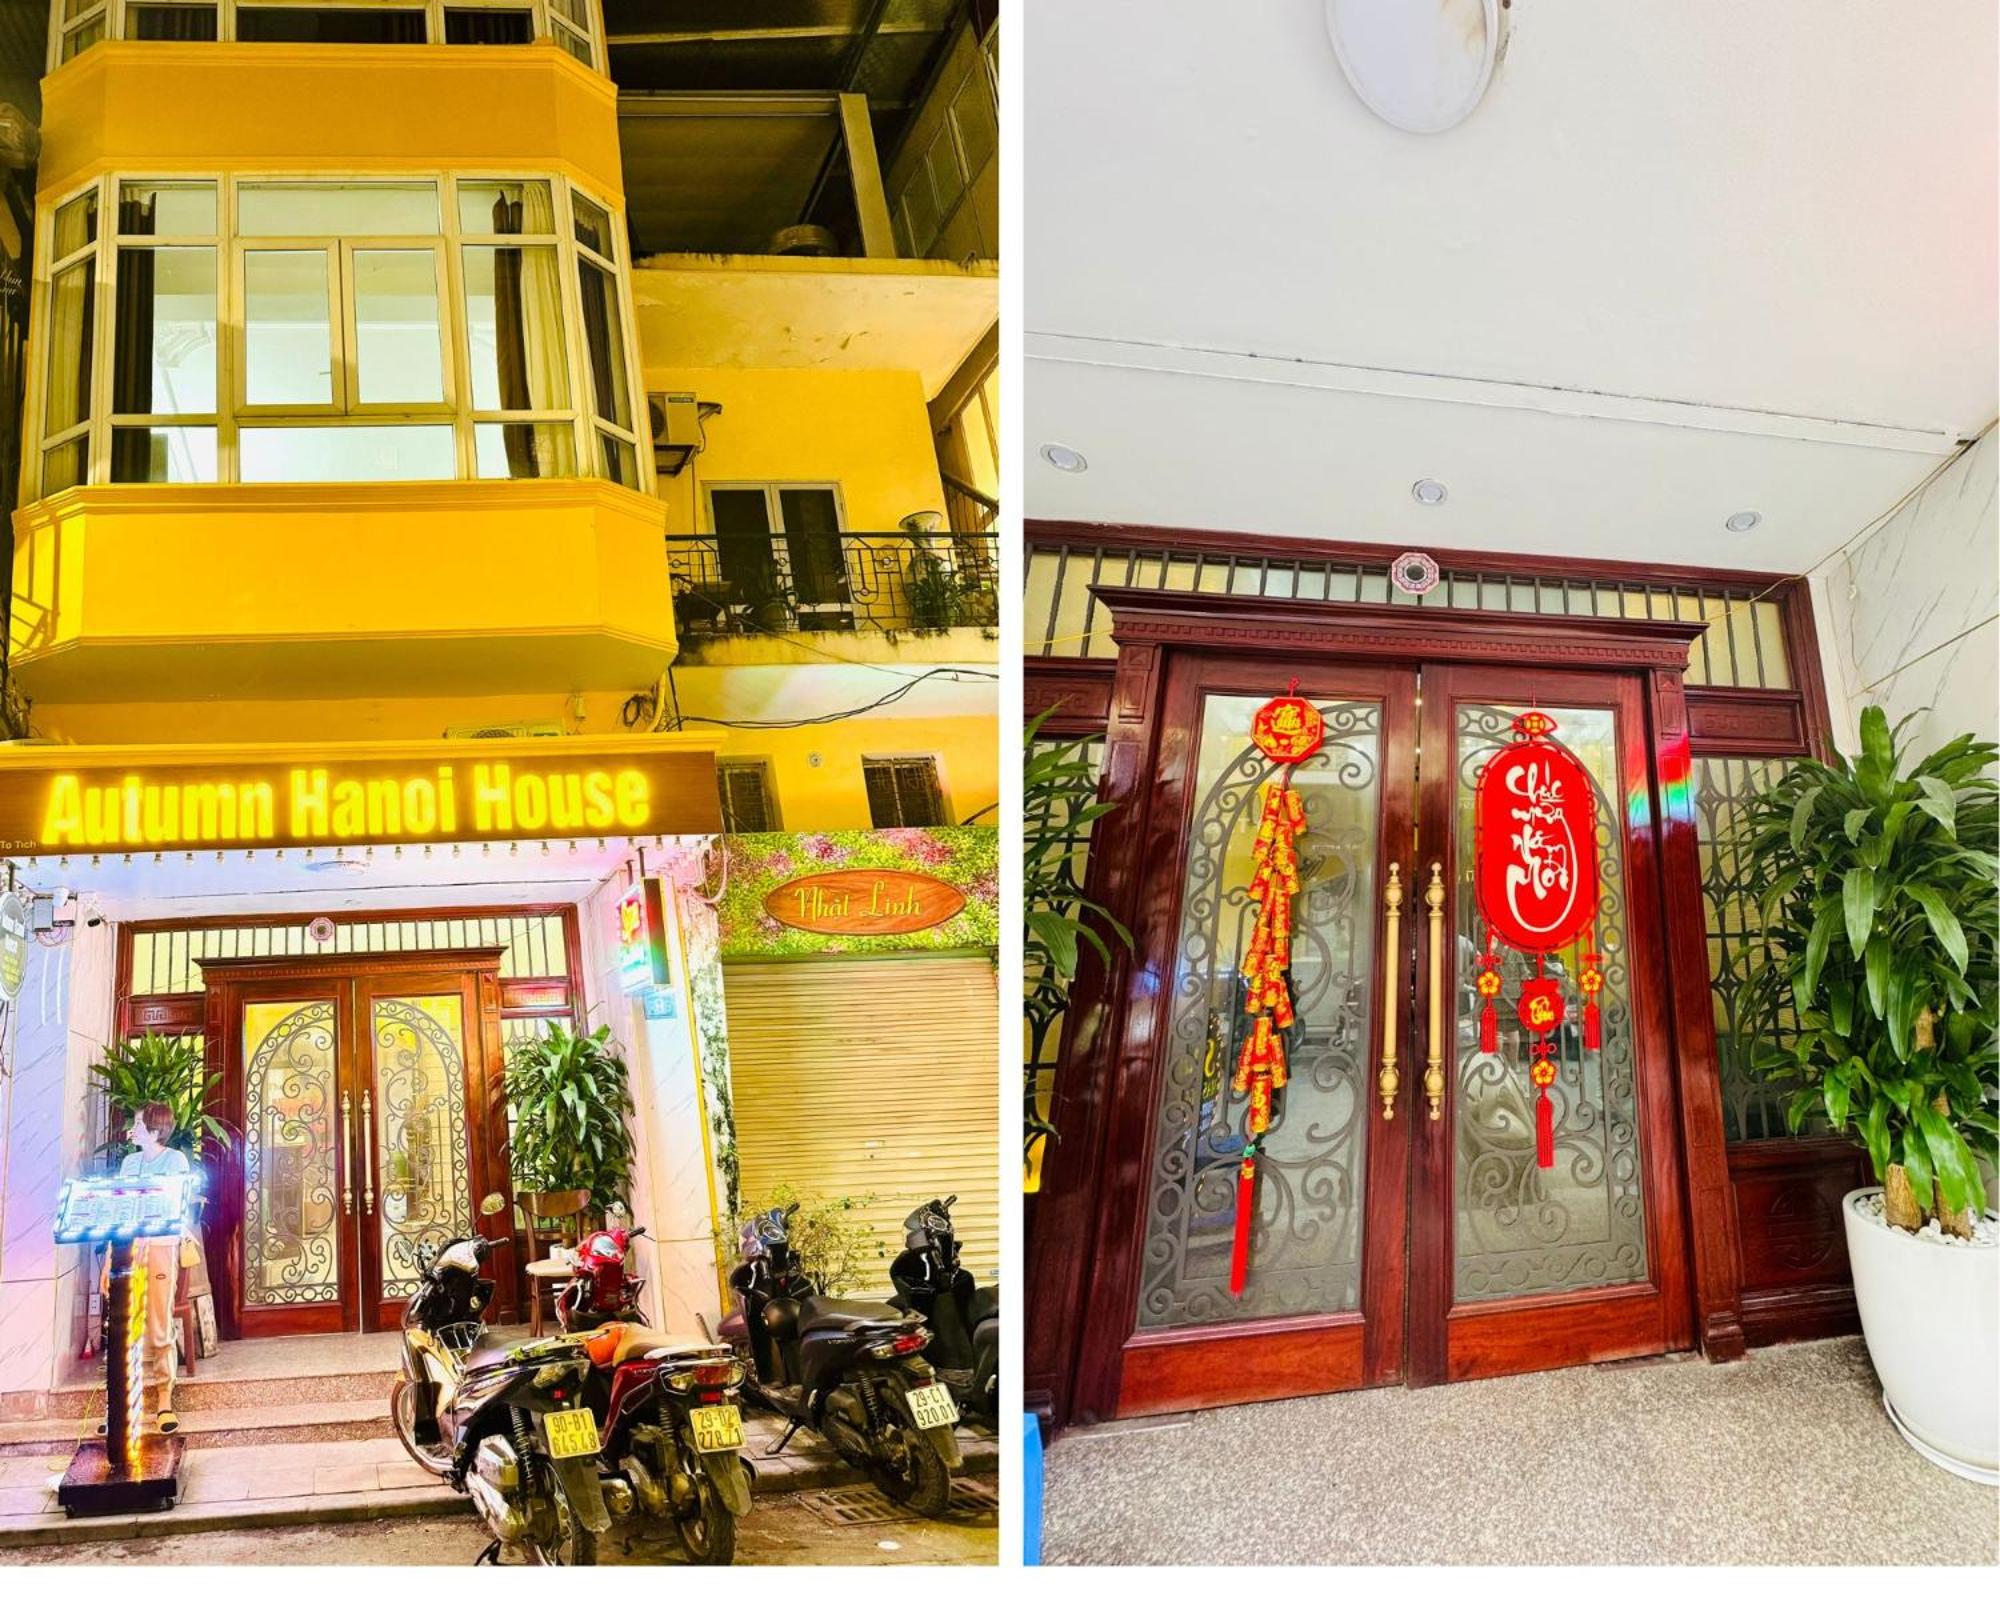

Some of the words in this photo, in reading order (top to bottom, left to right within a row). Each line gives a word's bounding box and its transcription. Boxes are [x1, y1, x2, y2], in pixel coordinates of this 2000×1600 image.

[40, 774, 275, 845] Autumn
[290, 767, 457, 837] Hanoi
[473, 763, 651, 832] House
[858, 880, 921, 917] Linh
